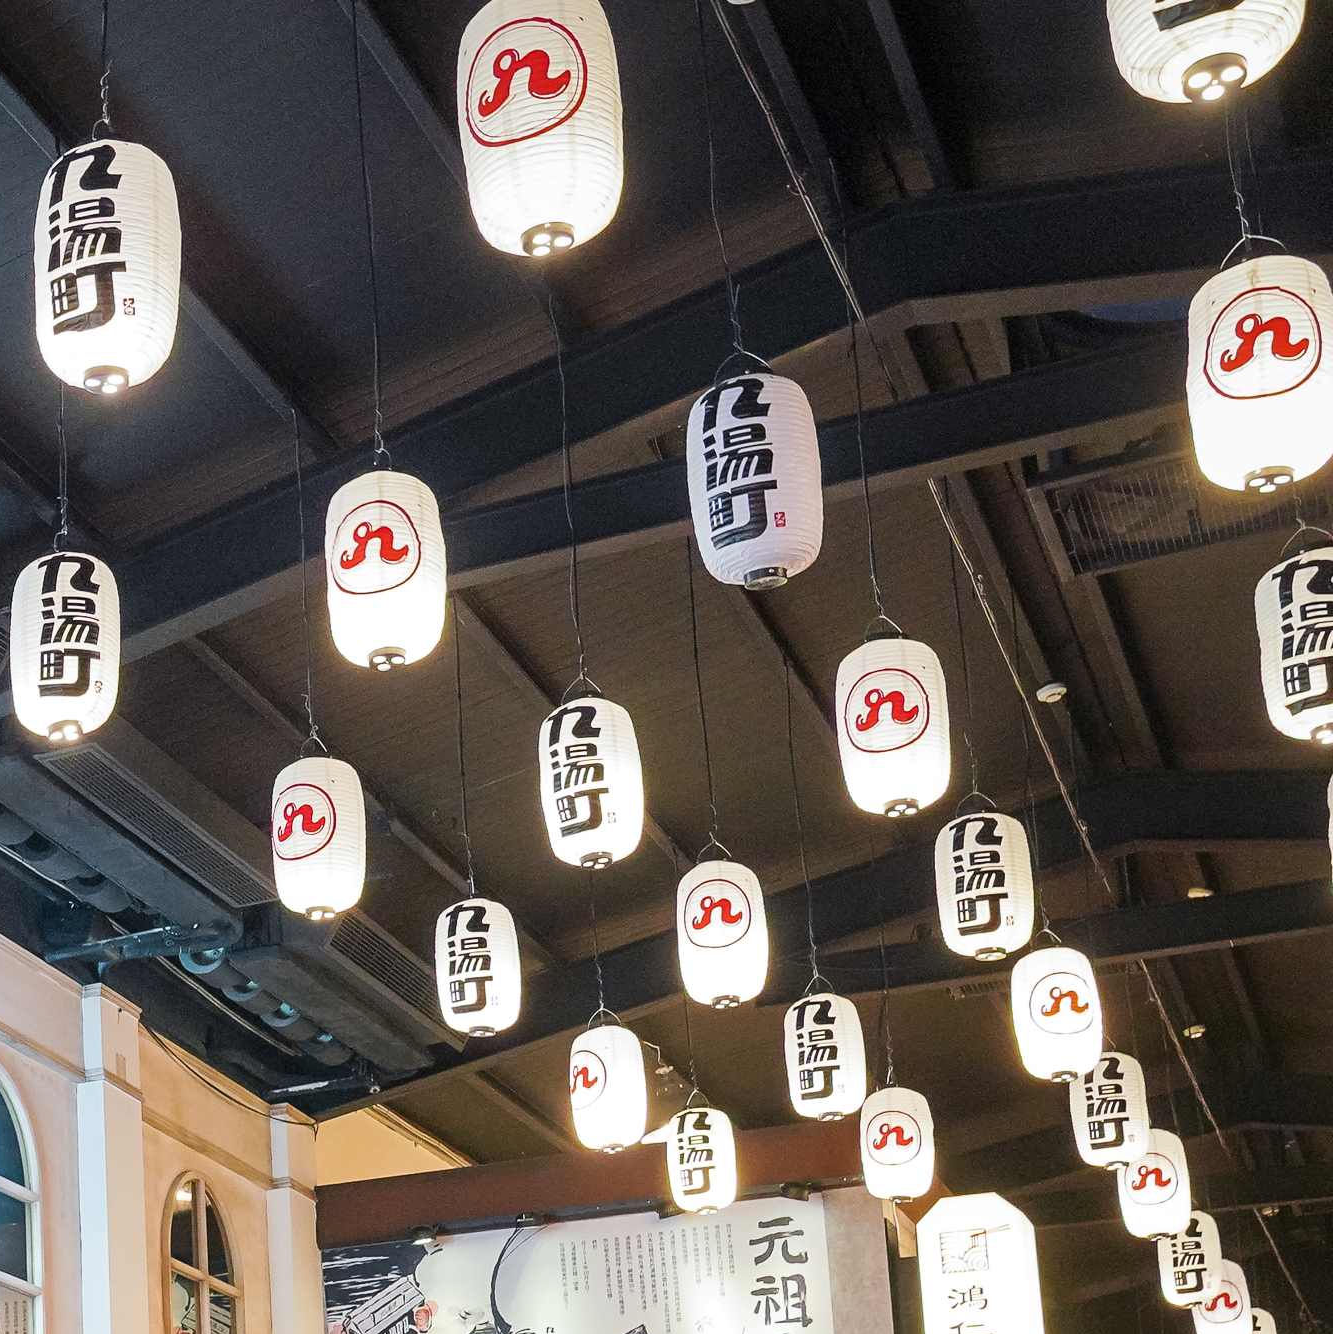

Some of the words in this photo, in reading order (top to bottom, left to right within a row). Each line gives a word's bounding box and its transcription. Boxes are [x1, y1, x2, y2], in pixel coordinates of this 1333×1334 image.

[48, 143, 126, 333] 九湯町
[700, 374, 779, 550] 九湯町
[37, 554, 102, 698] 九湯町
[547, 703, 610, 837] 九湯町
[948, 813, 1010, 934] 九湯町
[445, 899, 493, 1012] 九湯町
[792, 995, 840, 1100] 九湯町
[673, 1107, 712, 1195] 九湯町
